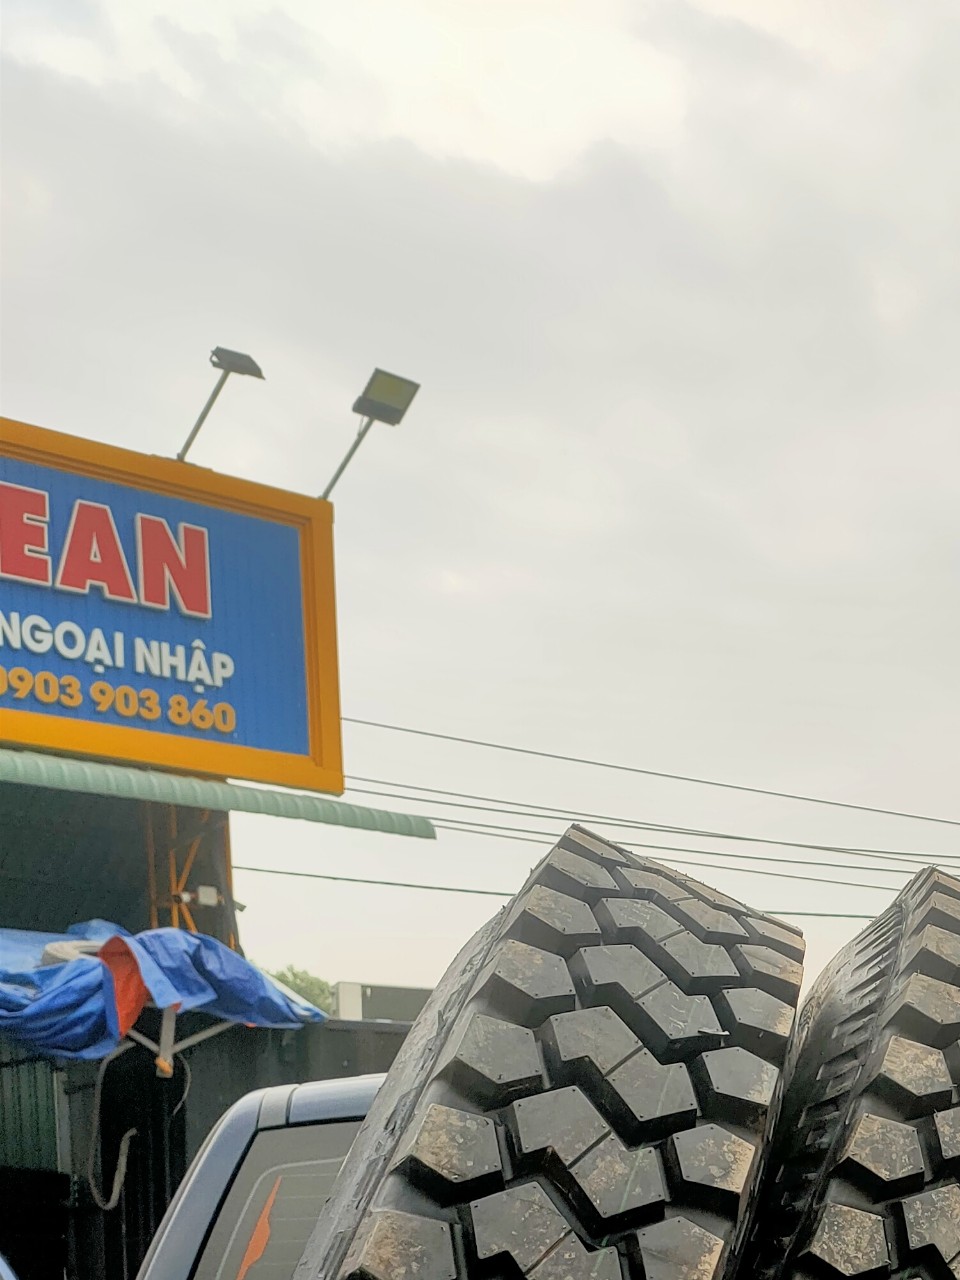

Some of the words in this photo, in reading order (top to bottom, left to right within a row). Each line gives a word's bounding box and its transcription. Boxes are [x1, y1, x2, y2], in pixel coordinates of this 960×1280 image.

[0, 480, 212, 619] EAN
[0, 610, 125, 673] NGOẠI
[134, 638, 235, 694] NHẬP
[90, 680, 162, 721] 903
[168, 694, 236, 733] 860
